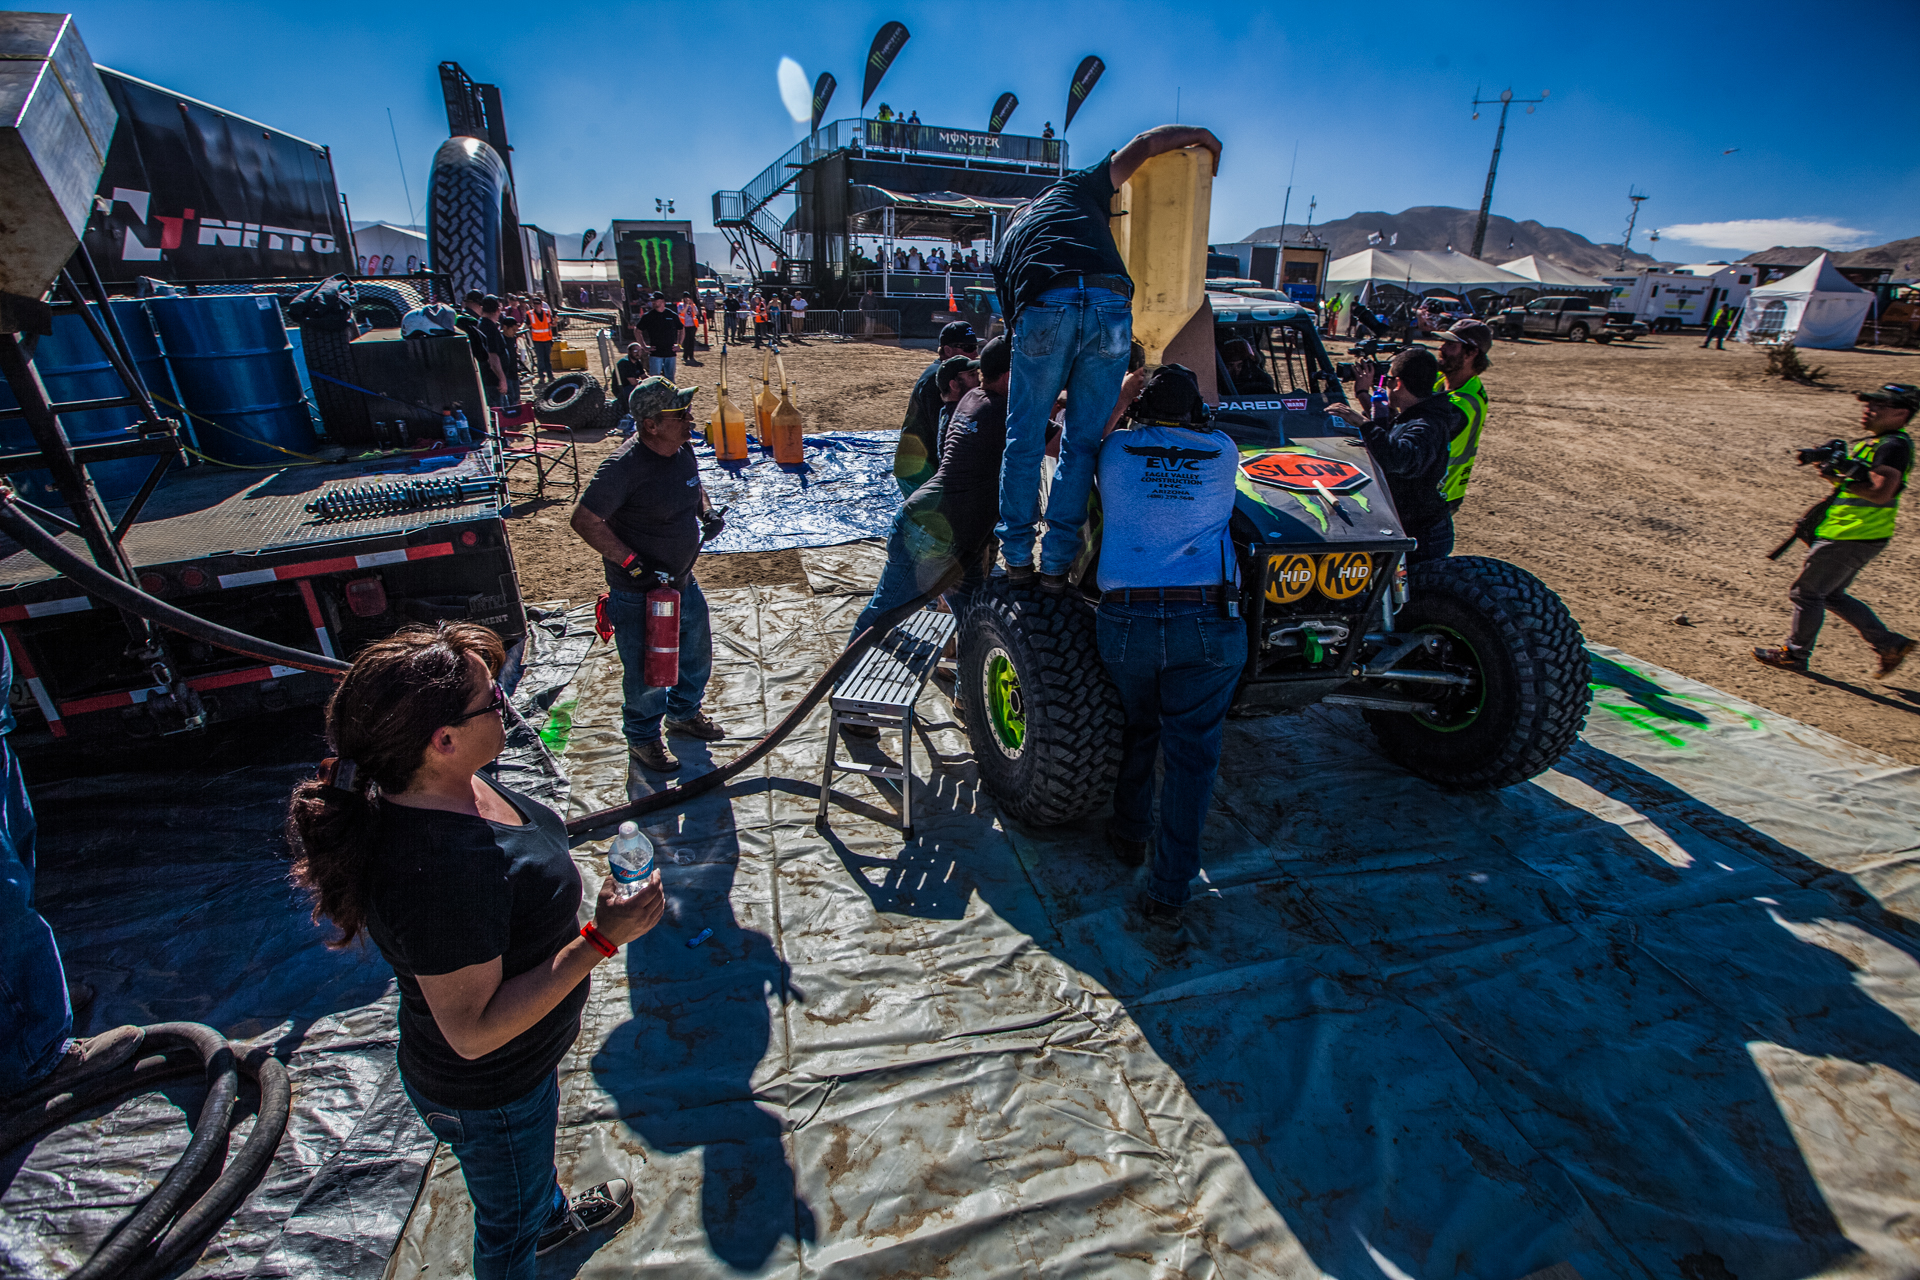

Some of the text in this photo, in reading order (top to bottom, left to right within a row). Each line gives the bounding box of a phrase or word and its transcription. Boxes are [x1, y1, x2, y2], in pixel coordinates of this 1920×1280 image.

[939, 131, 1000, 149] MONSTER
[1146, 458, 1200, 472] EVC
[1252, 463, 1348, 477] SLOW
[1141, 477, 1203, 485] CONSTRUCTION
[1267, 555, 1309, 598] KC
[1279, 570, 1311, 582] HID
[1325, 553, 1367, 594] KC
[1338, 566, 1369, 579] HID
